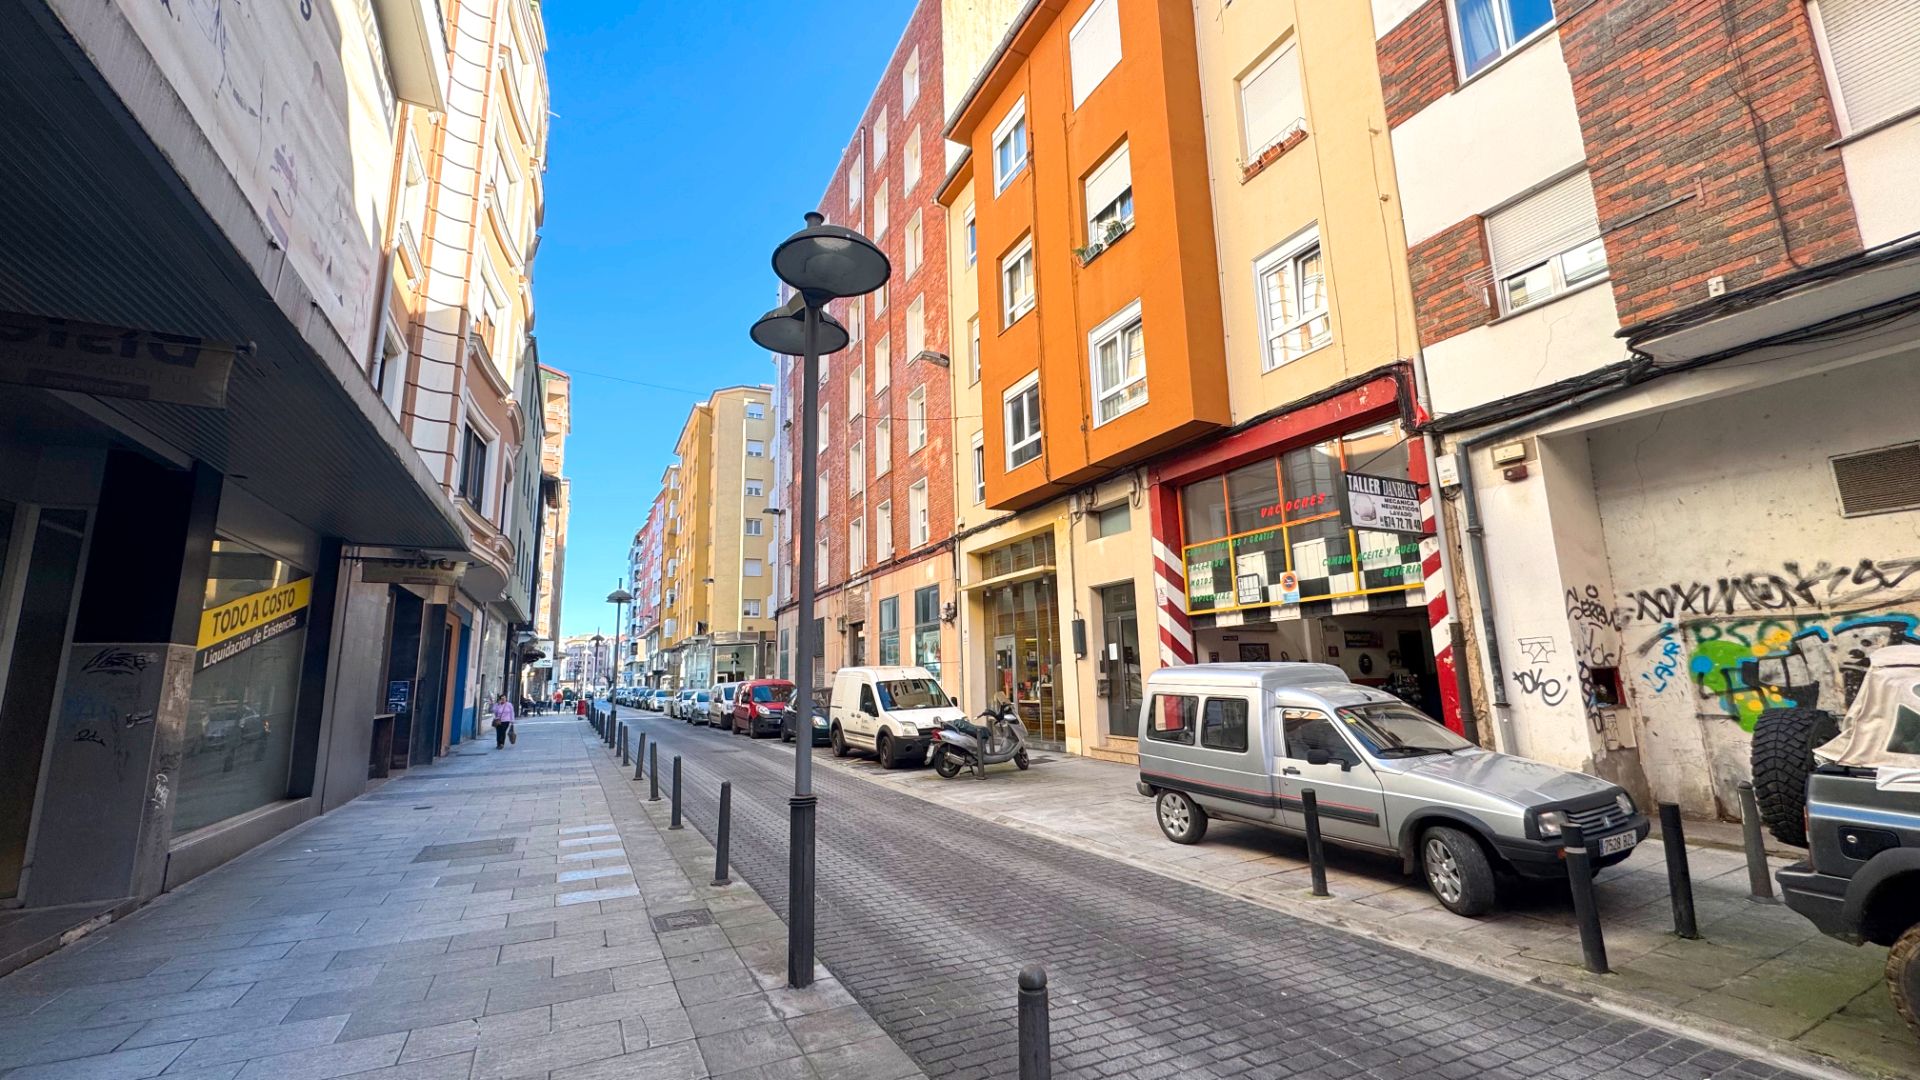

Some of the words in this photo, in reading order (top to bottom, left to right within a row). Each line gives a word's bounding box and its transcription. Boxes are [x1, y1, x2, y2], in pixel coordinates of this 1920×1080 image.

[1347, 475, 1380, 495] TALLER
[1322, 554, 1351, 566] CAMBIO
[1357, 549, 1384, 561] ACEITE
[1386, 547, 1392, 557] Y
[1394, 542, 1420, 554] RUED
[212, 603, 249, 637] TODO
[250, 600, 259, 622] A
[262, 588, 295, 617] COSTO
[203, 634, 251, 668] Liquidación
[252, 630, 262, 644] de
[263, 616, 297, 640] Existencias
[1604, 836, 1621, 853] 7528
